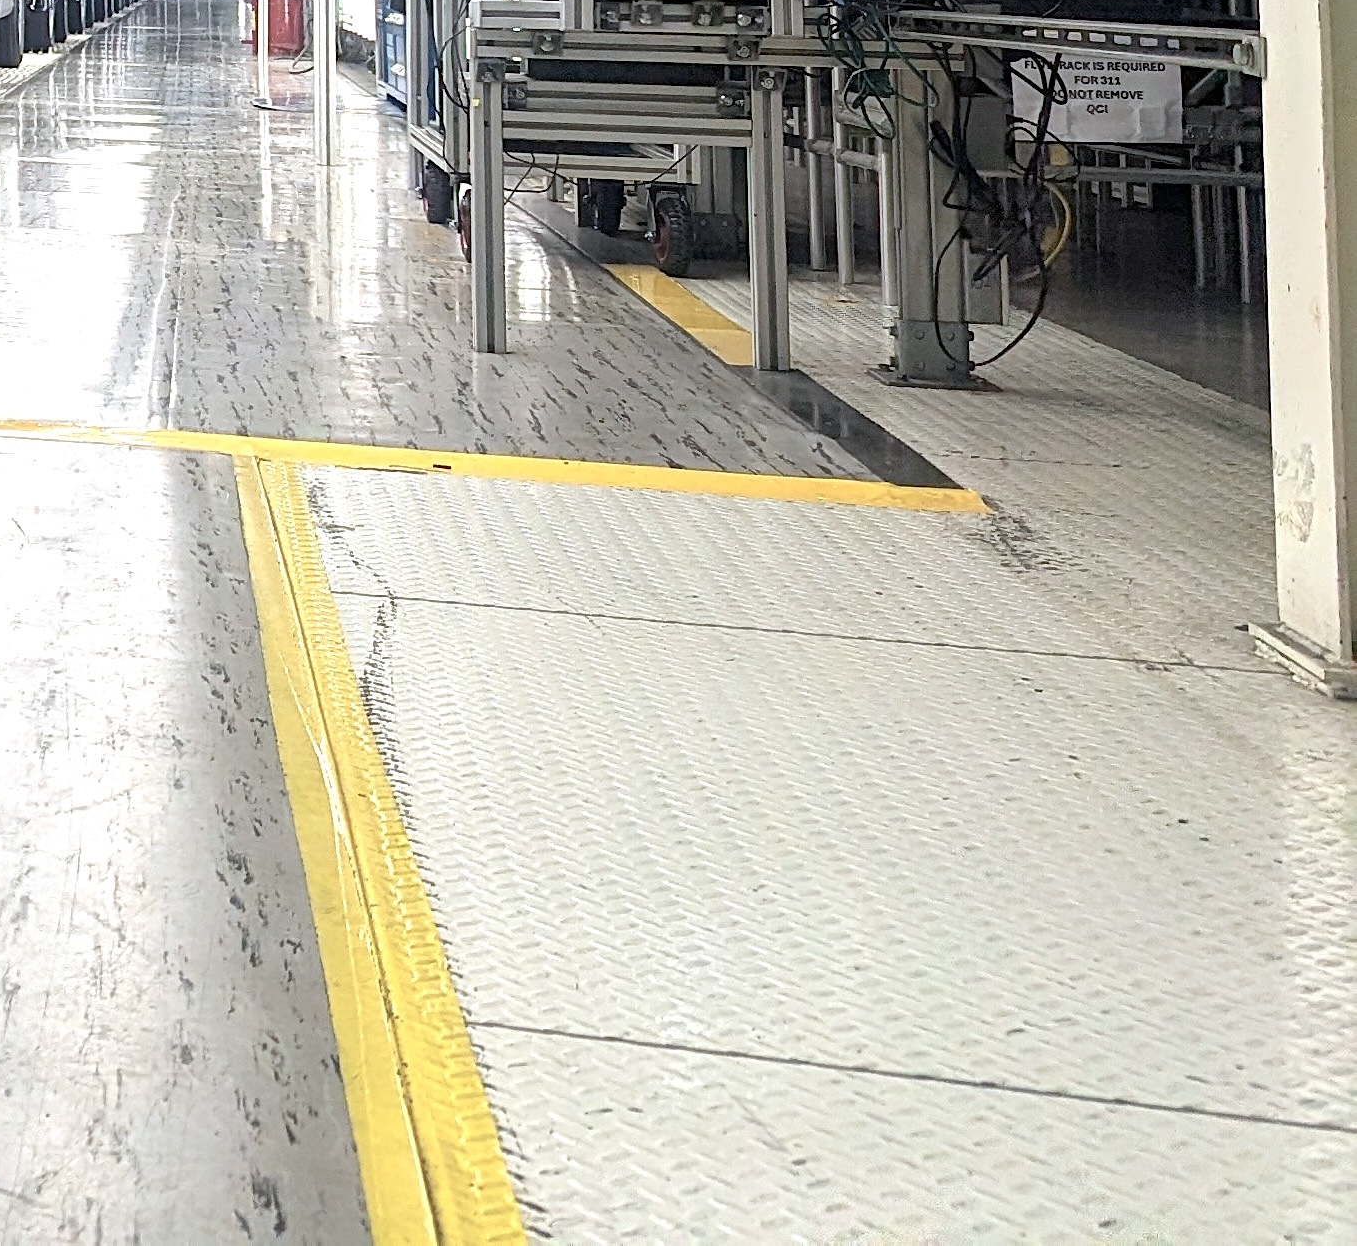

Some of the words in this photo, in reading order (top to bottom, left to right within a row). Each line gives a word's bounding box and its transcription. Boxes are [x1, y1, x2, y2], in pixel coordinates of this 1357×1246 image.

[1060, 61, 1090, 71] RACK
[1092, 62, 1105, 71] IS
[1107, 61, 1166, 72] REQUIRED
[1074, 75, 1099, 85] FOR
[1100, 76, 1121, 86] 311
[1069, 90, 1092, 100] NOT
[1095, 90, 1144, 100] REMOVE
